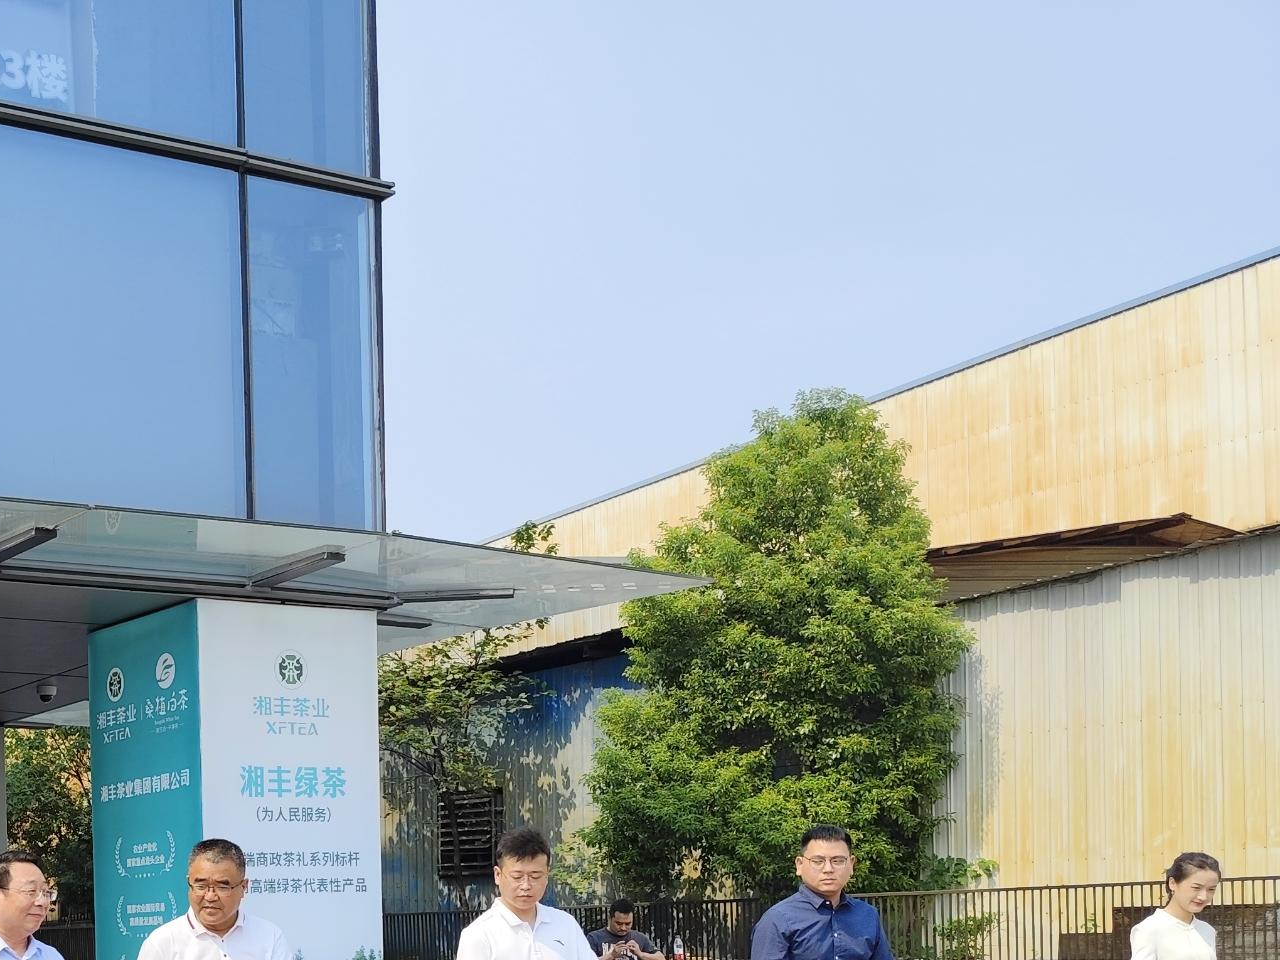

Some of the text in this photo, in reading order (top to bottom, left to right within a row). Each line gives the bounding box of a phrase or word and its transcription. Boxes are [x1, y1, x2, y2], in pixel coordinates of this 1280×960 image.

[96, 703, 137, 730] 湘丰茶业
[253, 696, 330, 718] 湘丰茶业
[103, 727, 131, 744] XFTEA
[266, 720, 319, 736] XFTEA
[100, 768, 190, 802] 湘丰茶业集团有限公司
[240, 765, 347, 799] 湘丰绿茶
